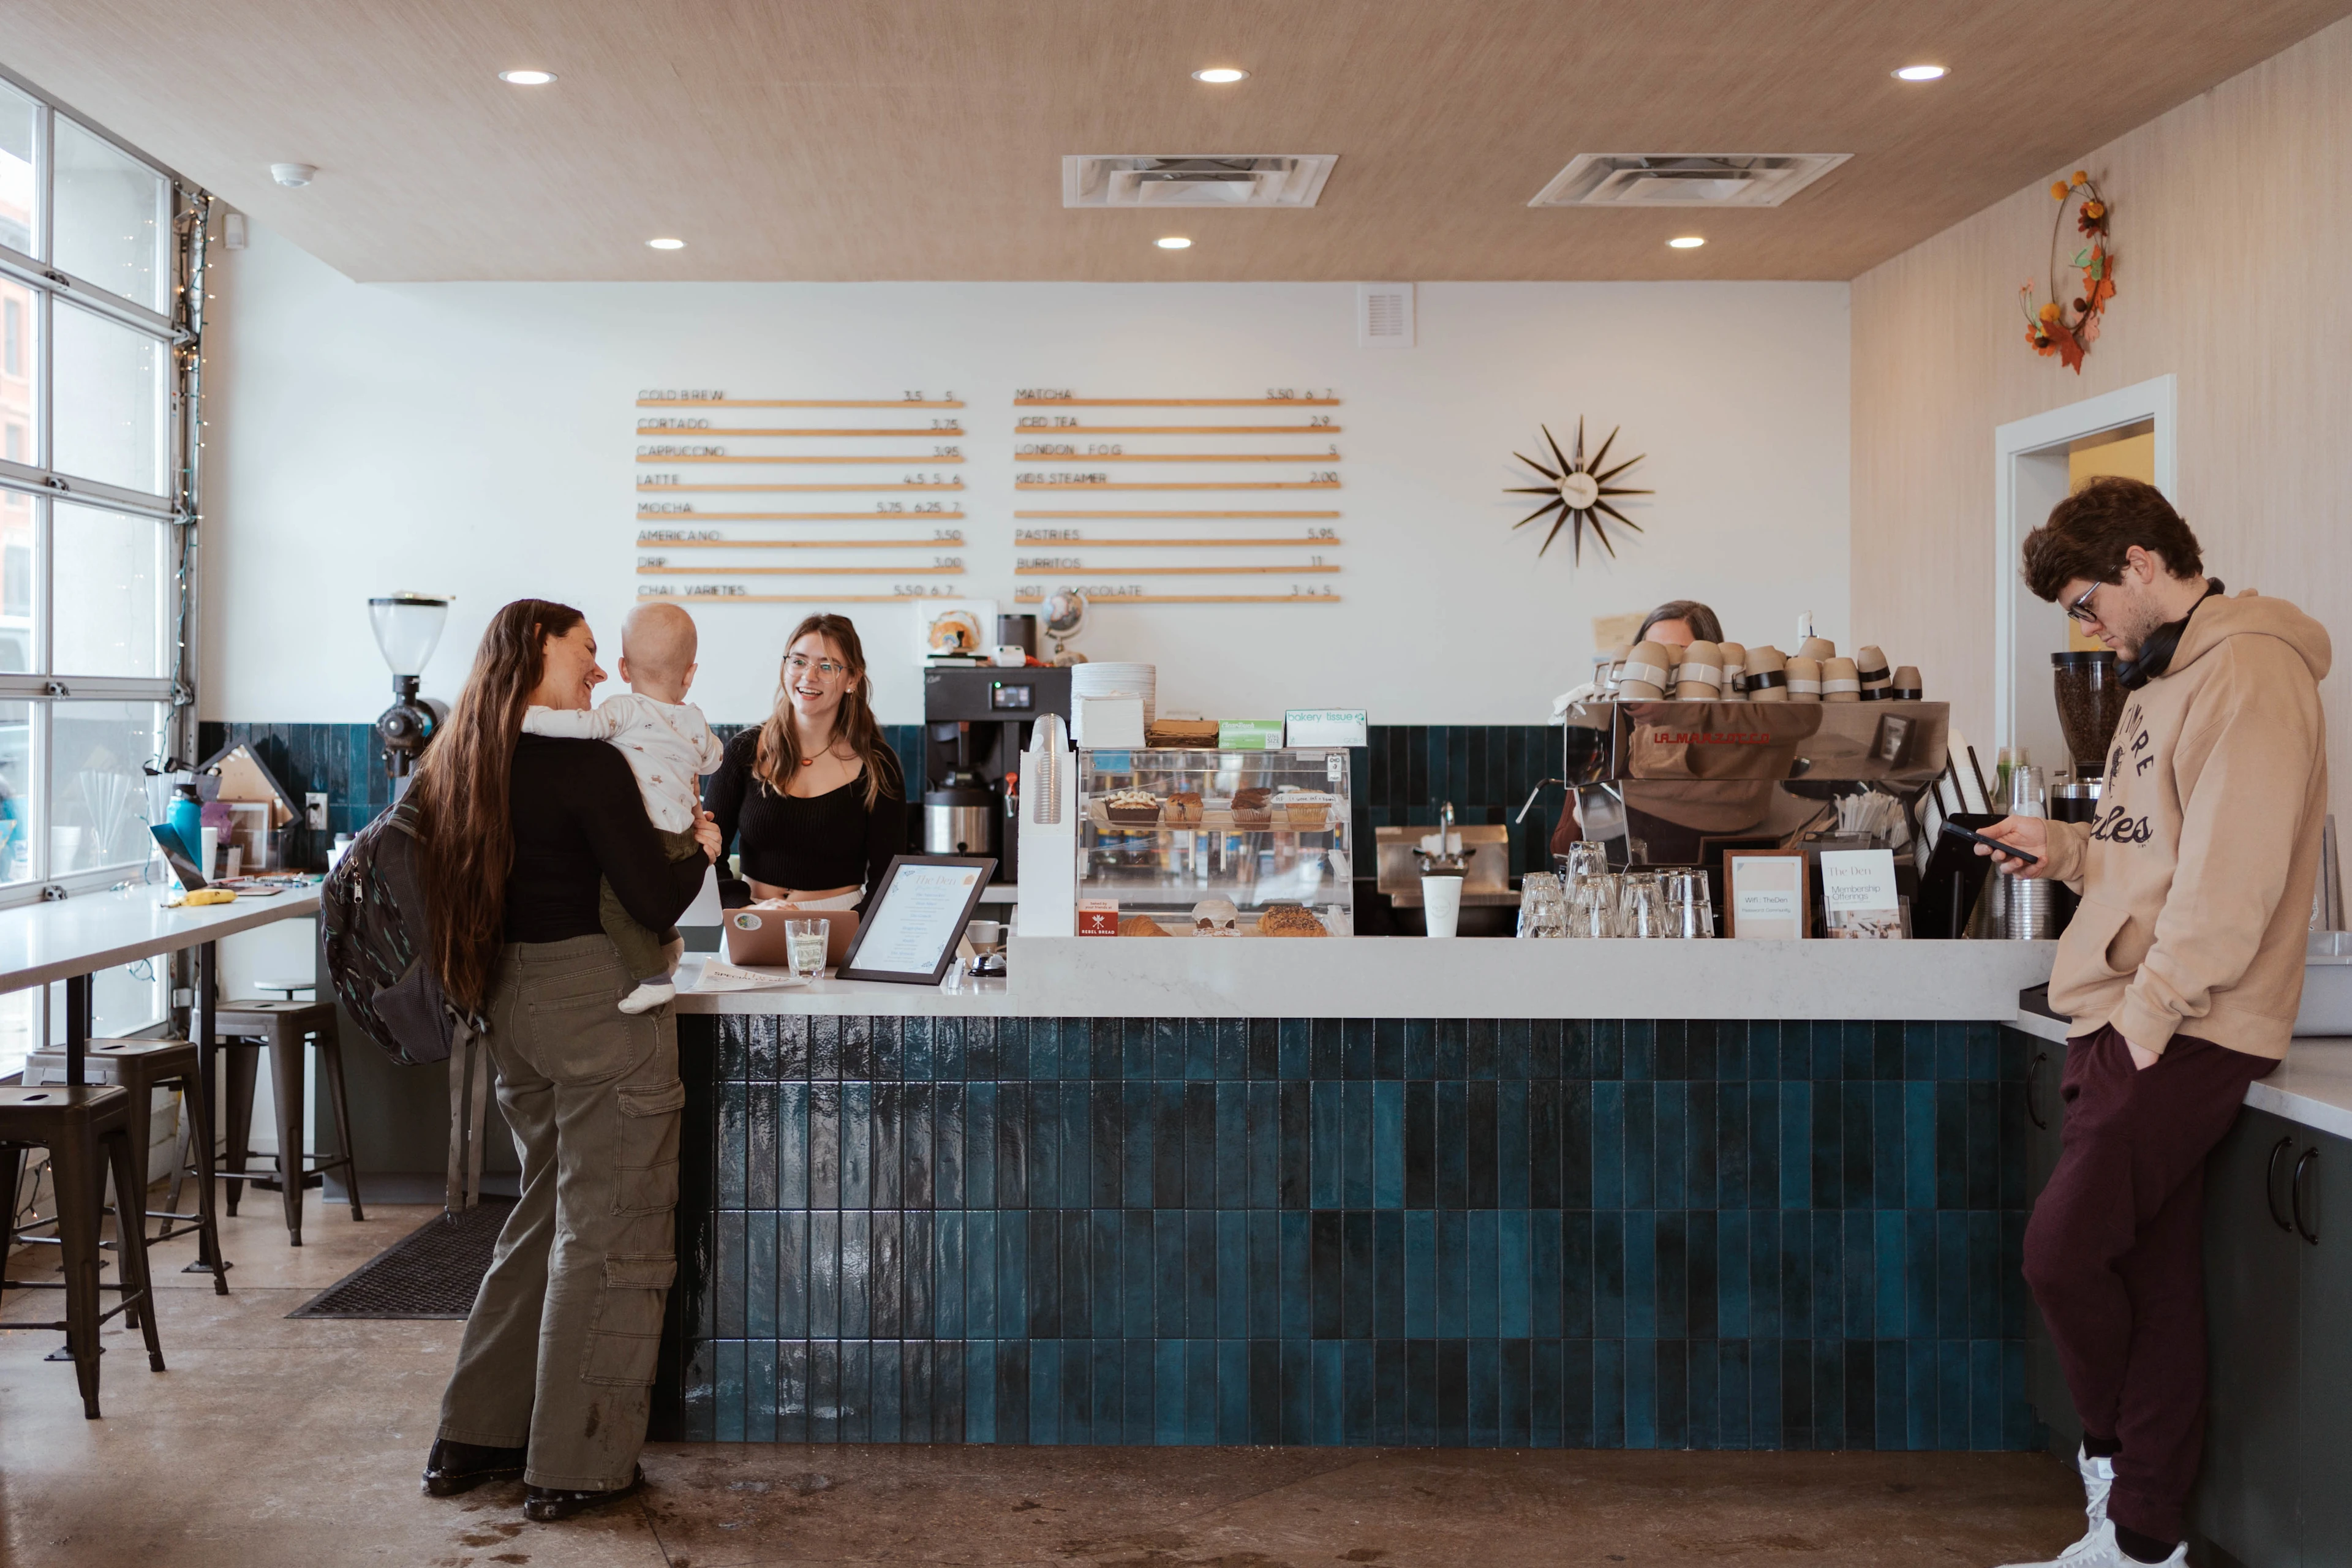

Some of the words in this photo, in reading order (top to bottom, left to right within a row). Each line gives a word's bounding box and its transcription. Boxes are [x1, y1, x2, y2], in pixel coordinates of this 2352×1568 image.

[638, 390, 676, 400] COLD
[681, 390, 723, 401] BREW
[904, 391, 922, 401] 3.5
[946, 391, 953, 401] 5
[1016, 389, 1072, 399] MATCHA
[1267, 389, 1294, 399] 5.50
[1306, 390, 1313, 399] 6
[1325, 388, 1332, 399] 7
[638, 418, 708, 429] CORTADO
[931, 419, 959, 430] 3.75
[1018, 417, 1048, 427] ICED
[1054, 417, 1077, 427] TEA
[1311, 416, 1330, 427] 2.9
[636, 445, 725, 456] CAPPUCCINO
[933, 447, 960, 457] 3.95
[1015, 443, 1074, 454] LONDON
[1088, 444, 1123, 454] FOG
[636, 474, 680, 485] LATTE
[904, 474, 924, 484] 4.5
[933, 473, 940, 484] 5
[953, 475, 960, 484] 6
[1016, 473, 1044, 483] KIDS
[1050, 473, 1107, 483] STEAMER
[1310, 472, 1338, 483] 2.00
[638, 502, 692, 513] MOCHA
[876, 502, 902, 513] 5.75
[914, 502, 941, 513] 6.25
[953, 502, 960, 513] 7
[638, 530, 720, 541] AMERICANO
[934, 530, 962, 540] 3.50
[1016, 529, 1080, 540] PASTRIES
[1307, 528, 1335, 539] 5.95
[638, 557, 666, 567] DRIP
[933, 557, 962, 568] 3.00
[1017, 557, 1082, 568] BURRITOS
[1311, 556, 1322, 567] 11
[638, 585, 675, 596] CHAI
[684, 585, 747, 596] VARIETIES
[894, 585, 924, 596] 5.50
[931, 586, 939, 595] 6
[946, 585, 954, 595] 7
[1015, 586, 1042, 596] HOT
[1291, 585, 1298, 596] 3
[1307, 586, 1314, 595] 4
[1323, 585, 1331, 595] 5
[1287, 712, 1322, 722] bakery
[1654, 733, 1669, 744] LA
[1676, 733, 1770, 744] MARZOCCO
[1828, 867, 1848, 876] The
[1850, 867, 1872, 875] Den
[916, 875, 934, 884] The
[936, 875, 957, 885] Den
[1831, 884, 1881, 894] Membership
